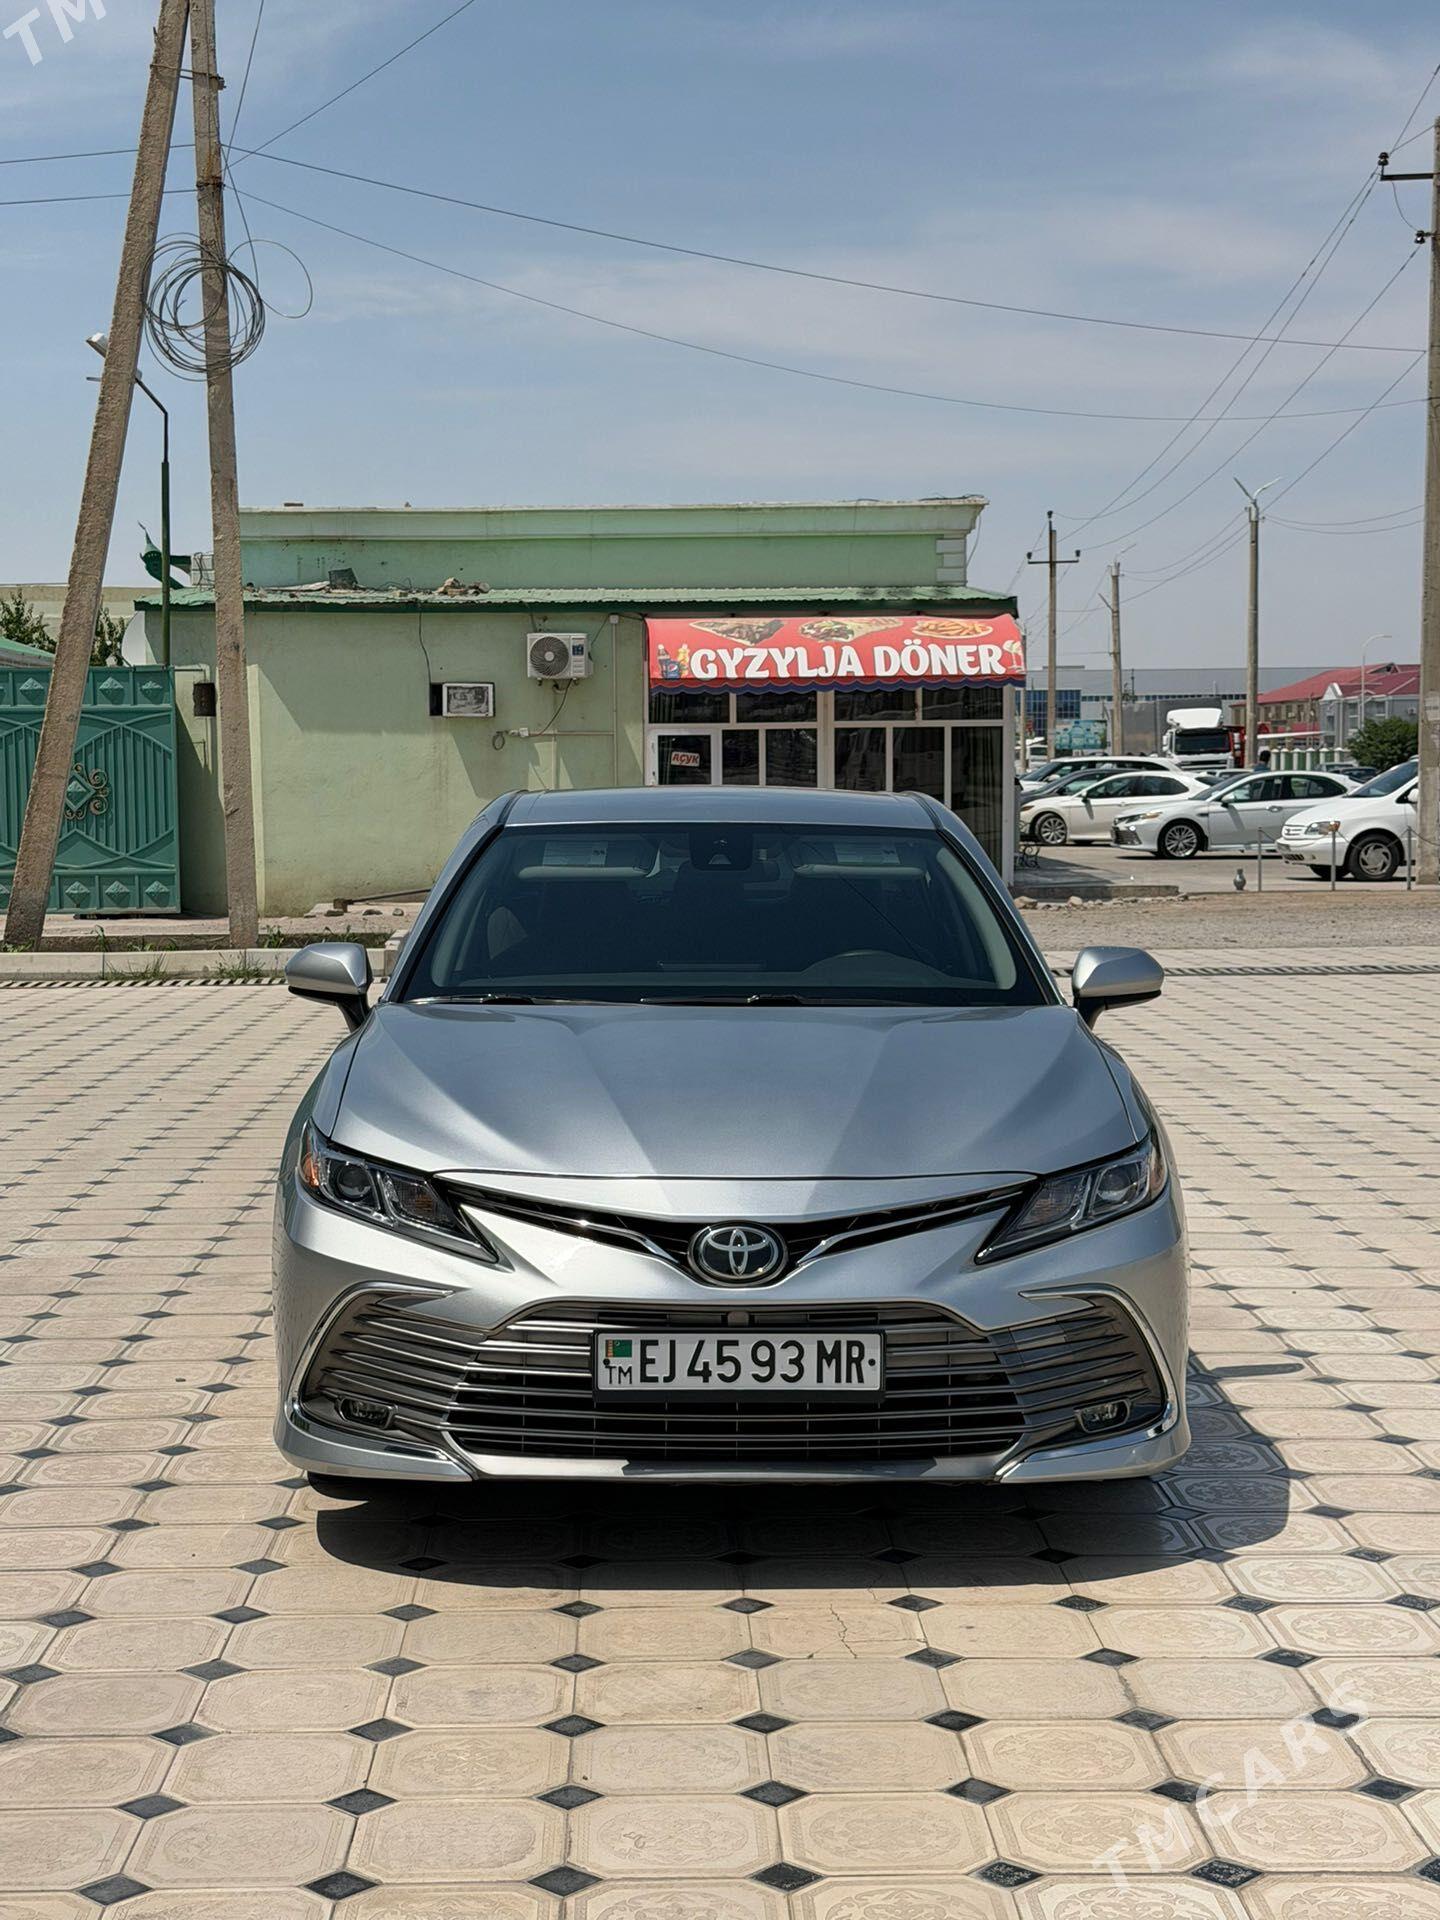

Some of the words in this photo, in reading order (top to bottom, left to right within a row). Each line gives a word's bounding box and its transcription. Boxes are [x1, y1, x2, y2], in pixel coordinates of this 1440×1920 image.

[690, 645, 864, 679] GYZYLJA
[873, 639, 1006, 676] DÖNER
[605, 1366, 632, 1384] TM
